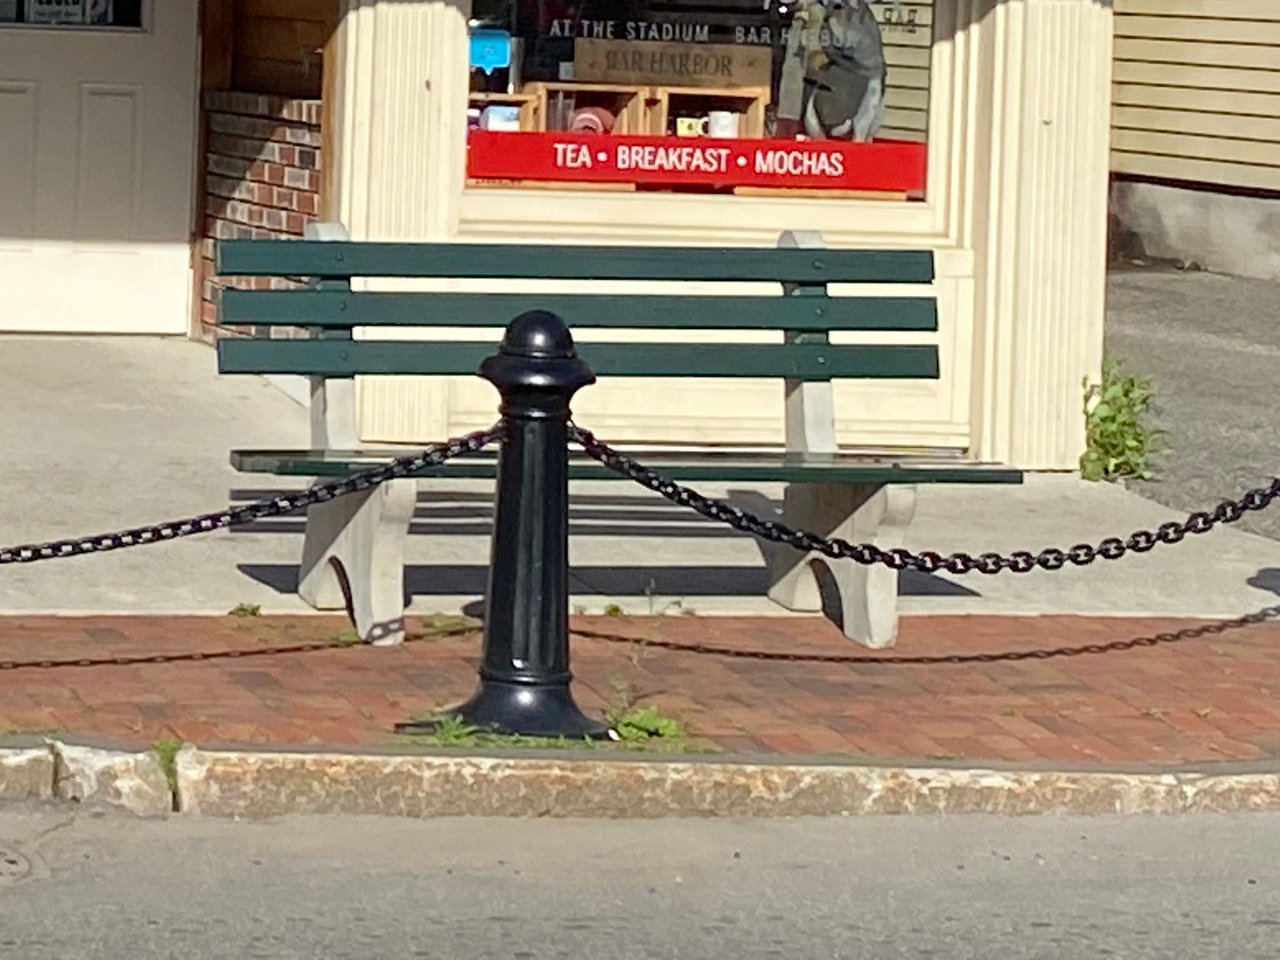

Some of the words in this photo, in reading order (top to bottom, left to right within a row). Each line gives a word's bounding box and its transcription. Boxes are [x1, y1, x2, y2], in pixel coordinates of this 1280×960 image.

[549, 20, 569, 38] AT
[580, 20, 615, 39] THE
[626, 22, 710, 42] STADIUM
[735, 26, 771, 44] BAR
[605, 49, 642, 71] BAR
[649, 51, 733, 77] HARBOR
[553, 142, 592, 167] TEA
[617, 145, 731, 172] BREAKFAST
[755, 148, 844, 176] MOCHAS
